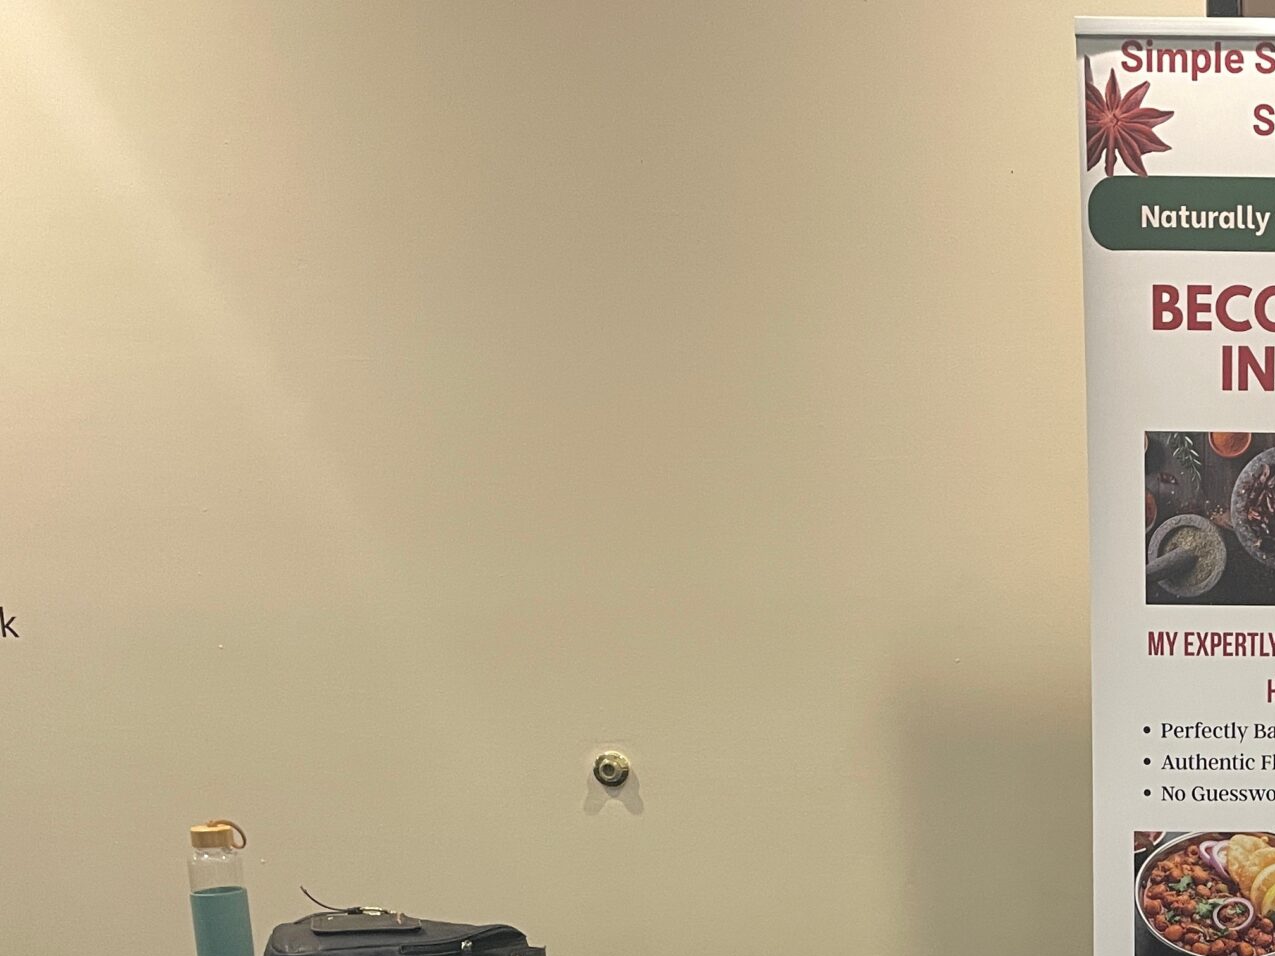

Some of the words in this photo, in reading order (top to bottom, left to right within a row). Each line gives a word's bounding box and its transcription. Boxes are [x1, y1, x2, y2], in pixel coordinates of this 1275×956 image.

[1121, 40, 1243, 81] Simple
[1142, 205, 1270, 236] Naturally
[1149, 632, 1178, 656] MY
[1162, 722, 1248, 743] Perfectly
[1161, 753, 1255, 770] Authentic
[1162, 786, 1185, 801] No
